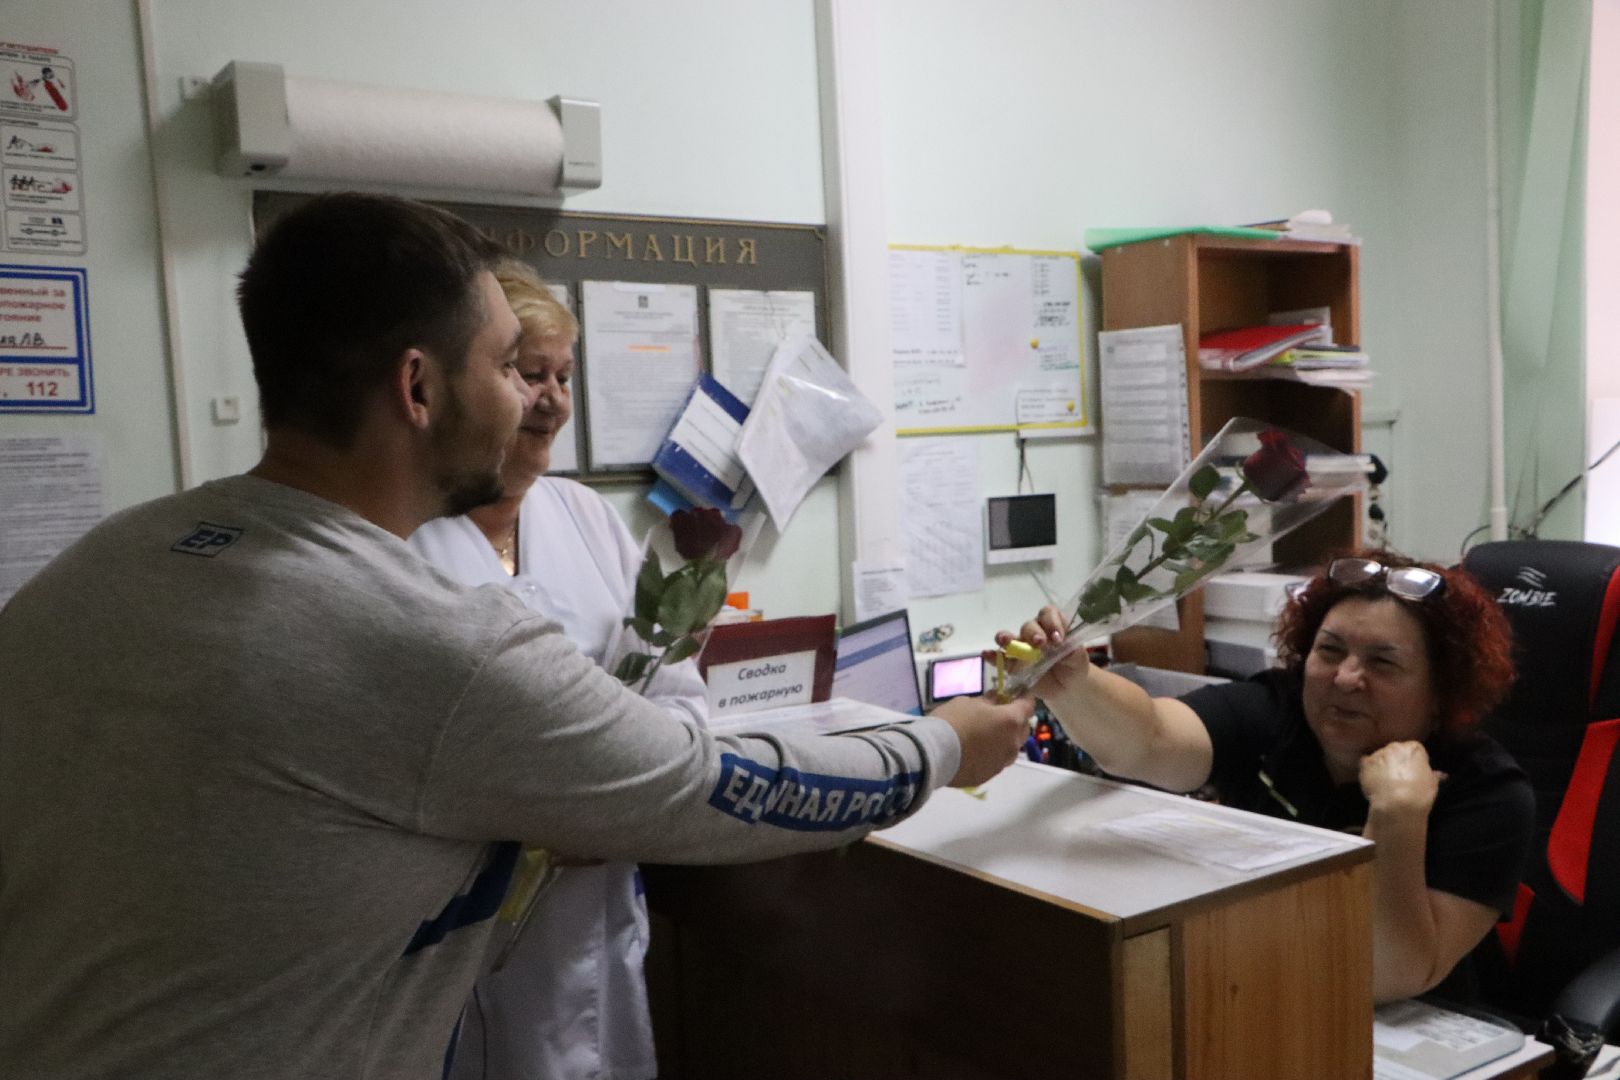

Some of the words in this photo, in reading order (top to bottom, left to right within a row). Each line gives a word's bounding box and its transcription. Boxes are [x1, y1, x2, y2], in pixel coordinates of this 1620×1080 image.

[26, 381, 59, 397] 112
[1496, 587, 1557, 607] ZOMBIE
[737, 661, 787, 681] Сводка
[718, 698, 727, 708] в
[729, 683, 803, 705] пожарную
